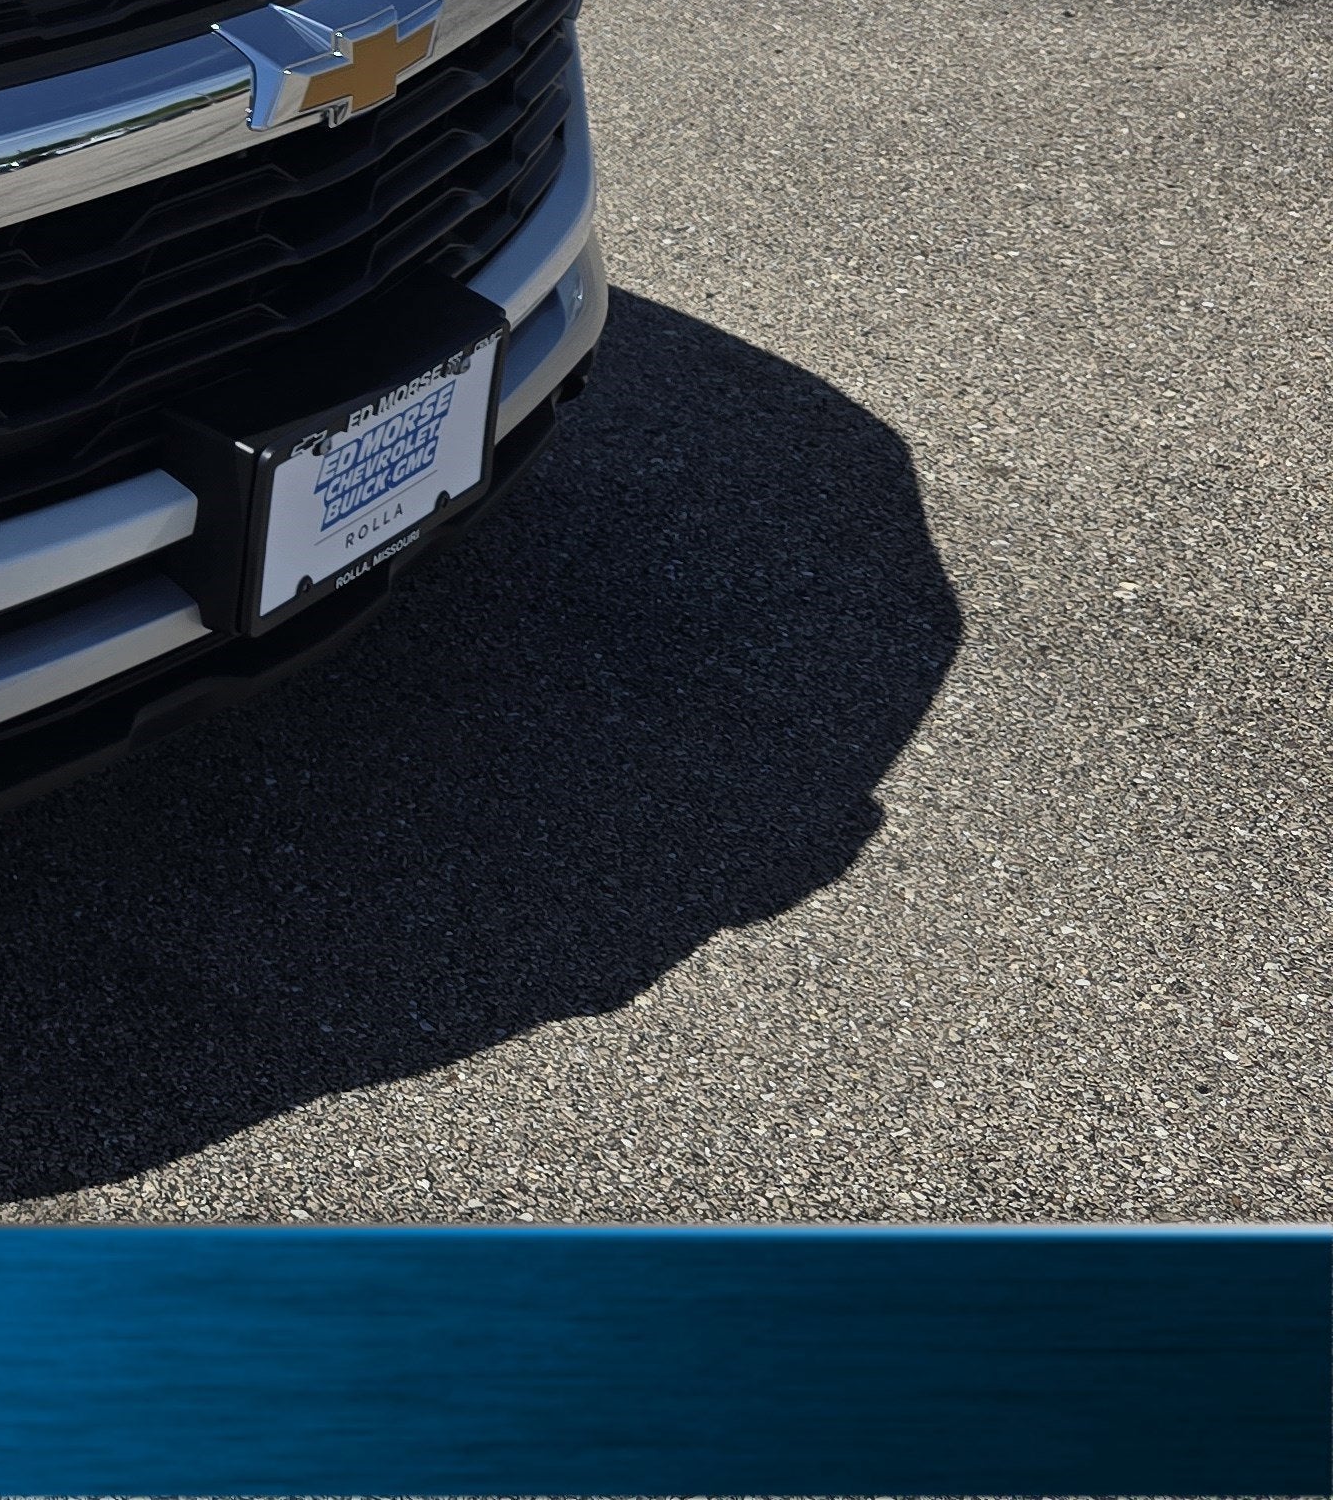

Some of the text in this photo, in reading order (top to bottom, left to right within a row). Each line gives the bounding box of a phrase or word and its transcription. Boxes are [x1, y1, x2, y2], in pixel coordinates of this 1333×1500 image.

[347, 404, 374, 427] ED
[377, 363, 443, 416] MORSE
[316, 382, 453, 485] ED MORSE
[325, 417, 441, 501] CHEVROLET
[345, 502, 403, 549] ROLLA
